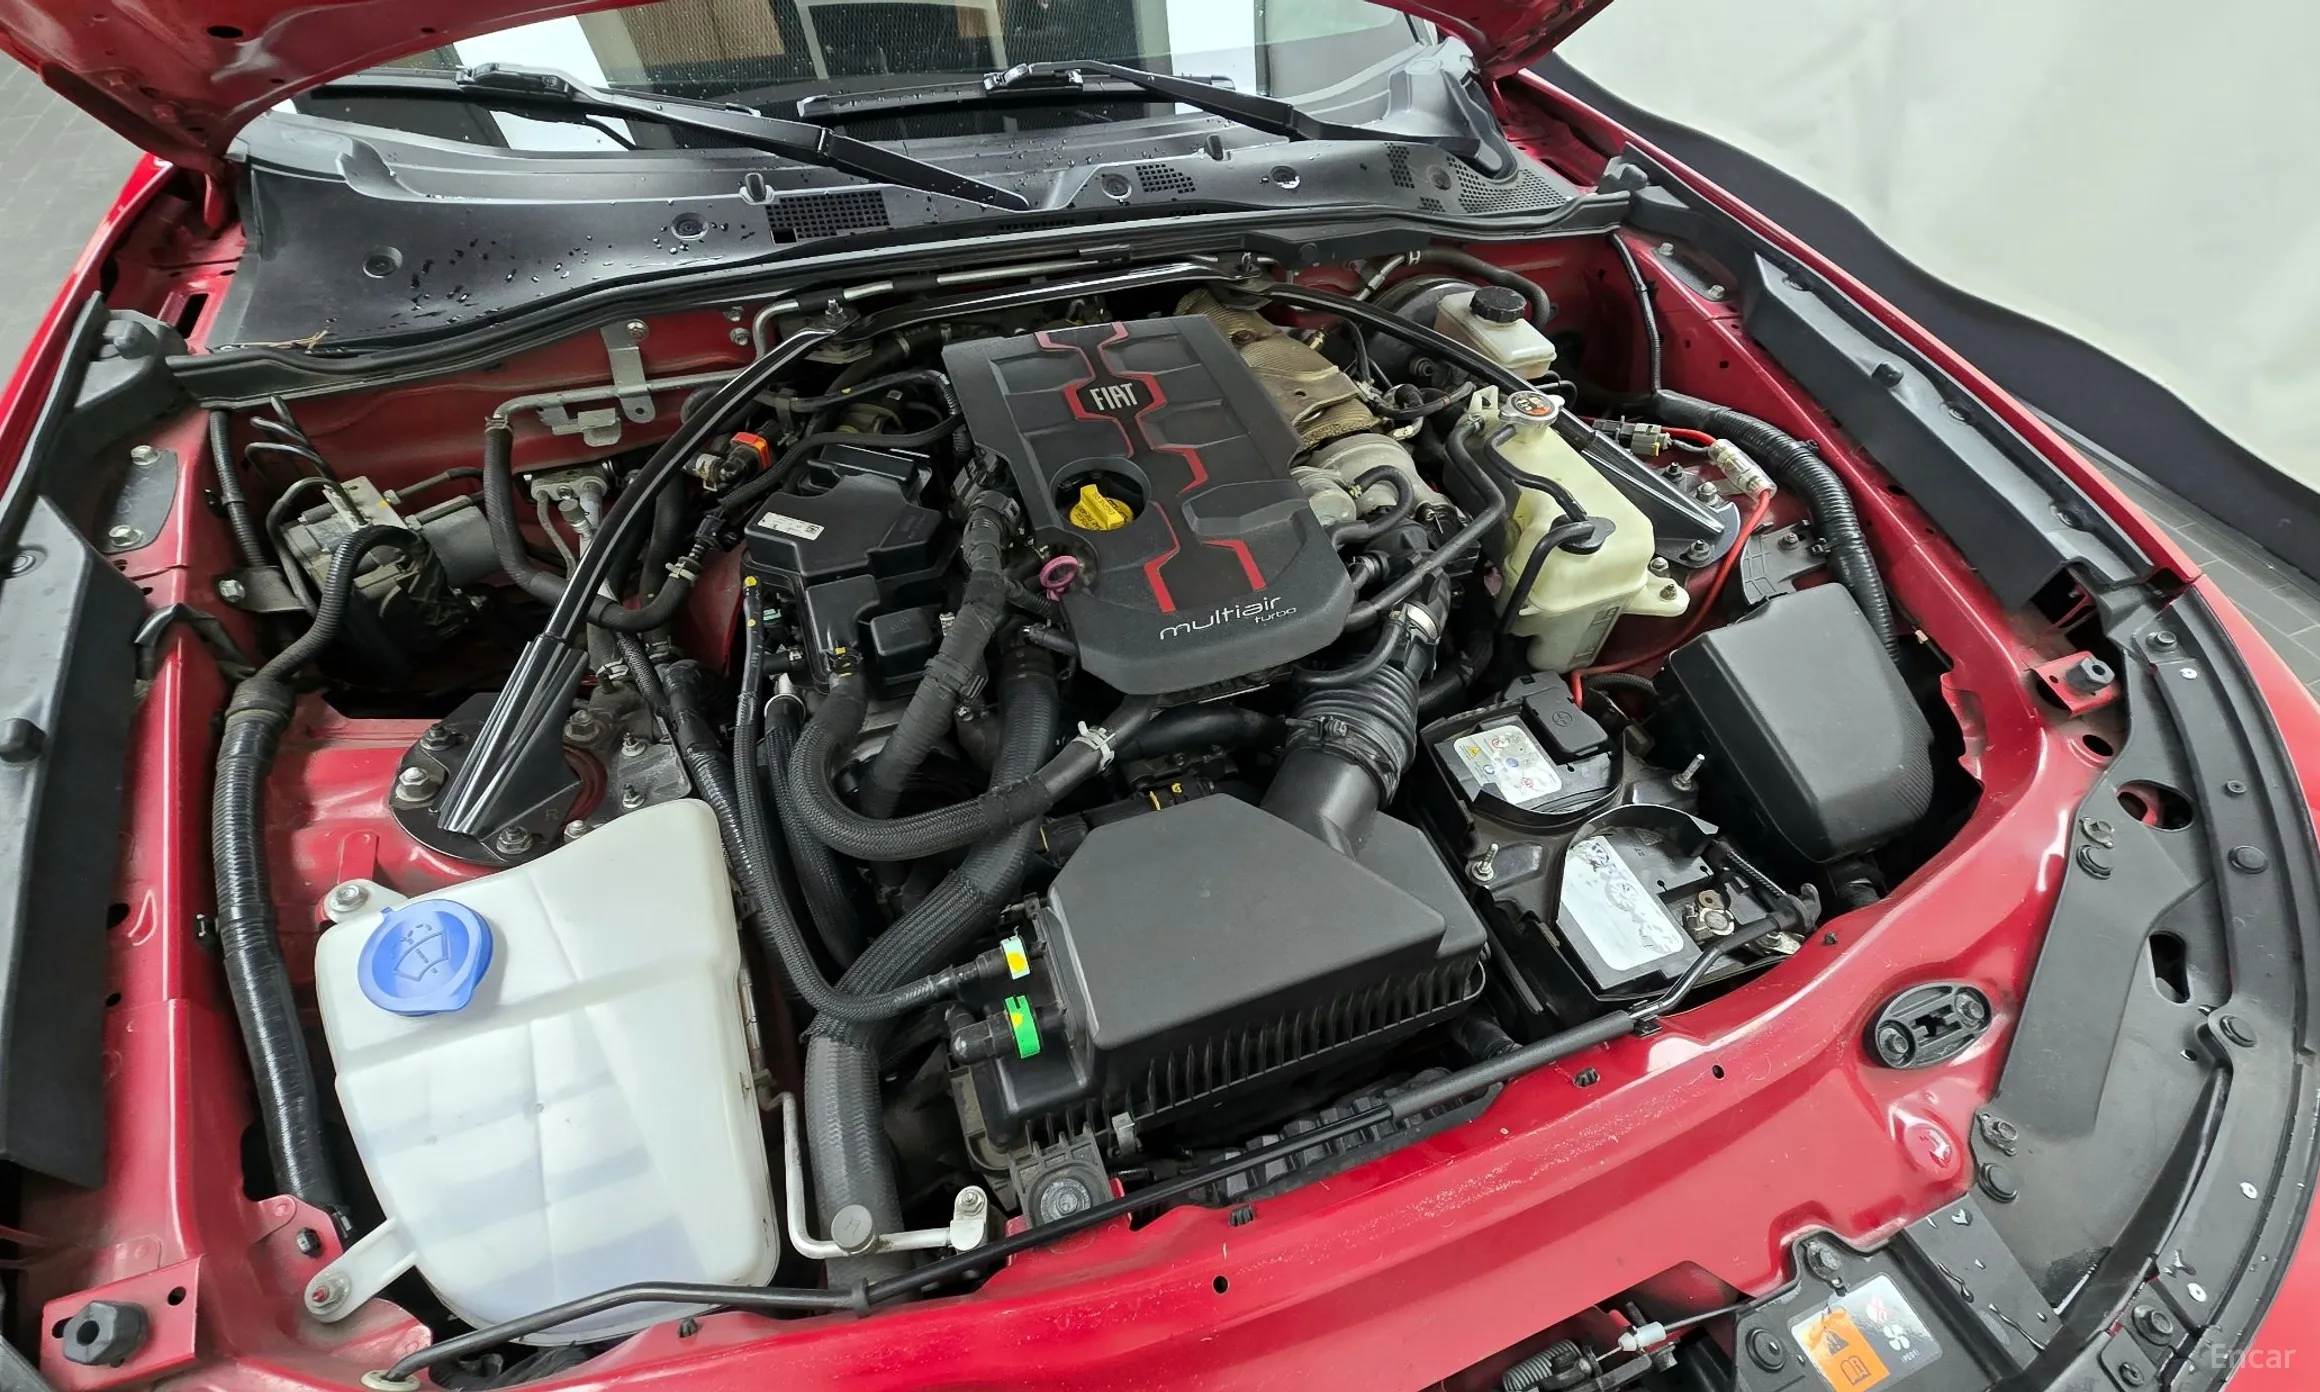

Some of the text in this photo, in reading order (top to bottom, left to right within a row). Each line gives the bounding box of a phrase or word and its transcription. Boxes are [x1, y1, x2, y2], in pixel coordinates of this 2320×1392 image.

[1089, 382, 1138, 411] FIAT
[1159, 597, 1282, 640] multiair
[1254, 607, 1298, 624] turbo
